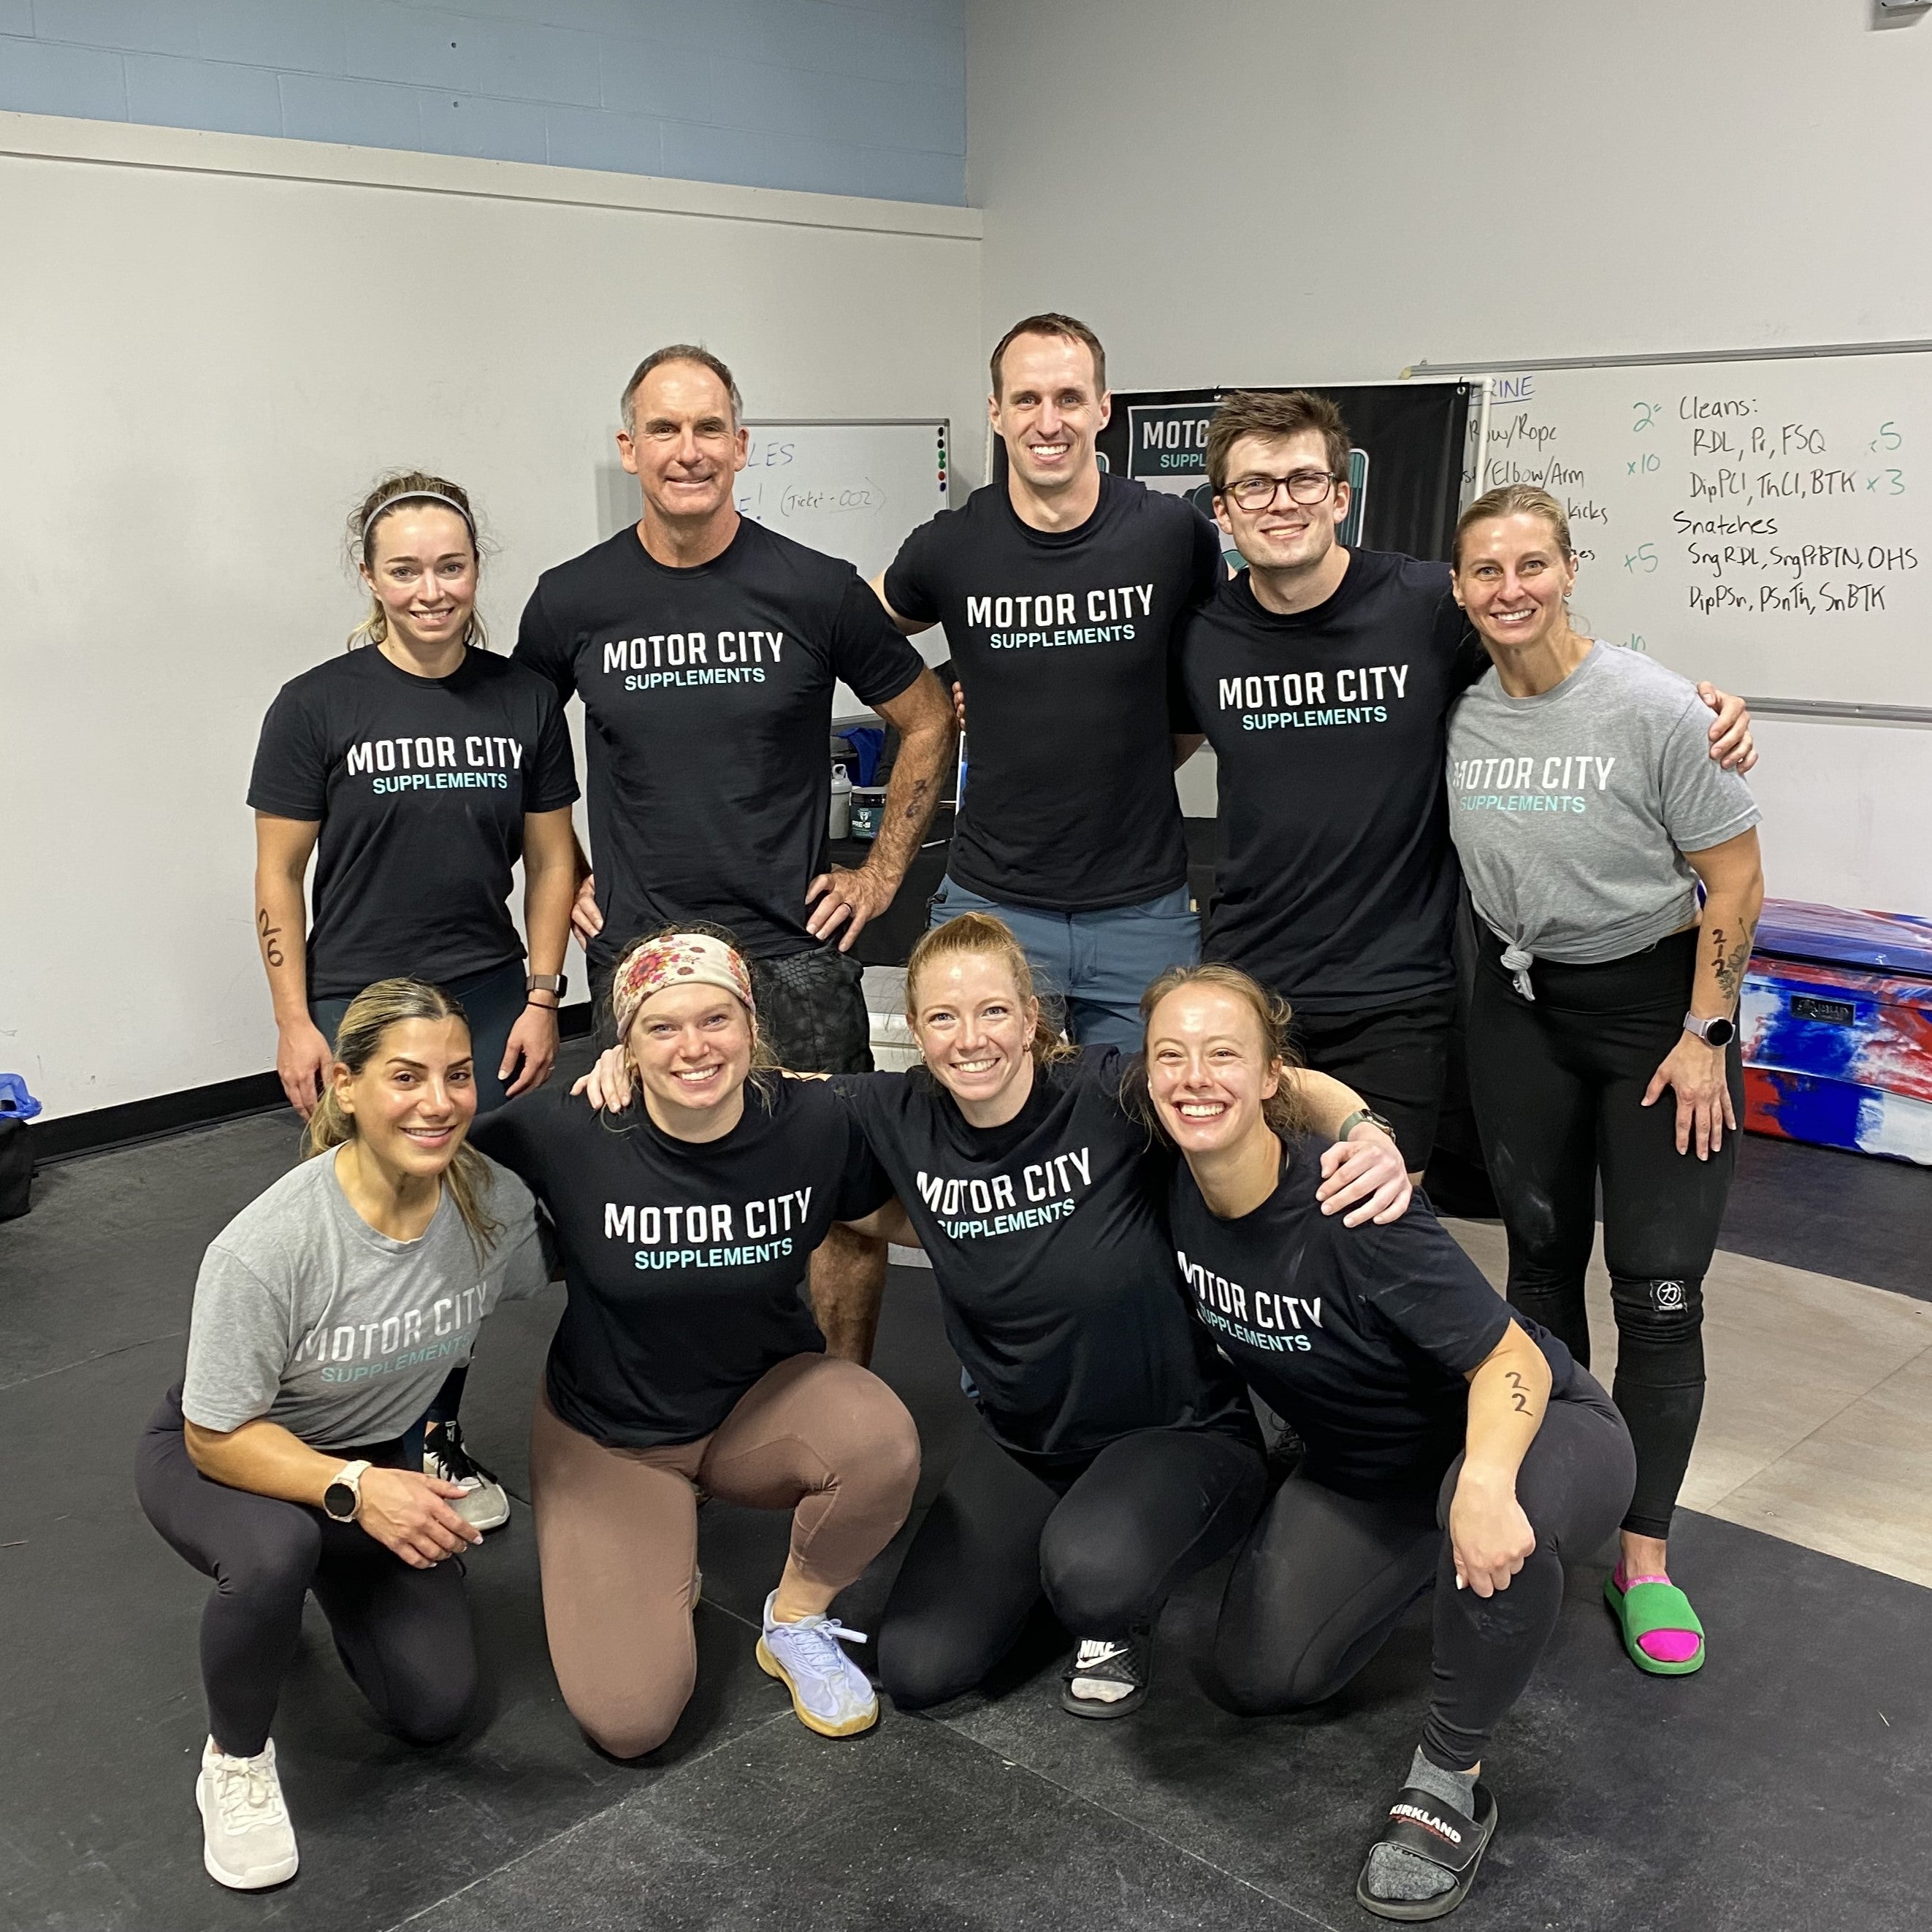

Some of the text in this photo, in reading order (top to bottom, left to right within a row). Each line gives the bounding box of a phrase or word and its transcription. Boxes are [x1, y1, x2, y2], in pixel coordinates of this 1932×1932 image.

[1680, 396, 1758, 419] Cleans:
[1142, 419, 1209, 450] MOTO
[1469, 413, 1558, 451] Rw/Rope
[1782, 424, 1826, 455] FSQ
[1567, 497, 1608, 524] kicks
[1673, 511, 1778, 535] Snatches
[1867, 546, 1918, 570] OHS
[967, 584, 1154, 628] MOTOR CITY
[603, 630, 784, 673] MOTOR CITY
[990, 624, 1135, 649] SUPPLEMENTS
[624, 667, 766, 692] SUPPLEMENTS
[1218, 664, 1410, 711] MOTOR CITY
[1242, 705, 1388, 730] SUPPLEMENTS
[347, 736, 523, 776] MOTOR CITY
[1453, 755, 1616, 791] MOTOR CITY
[373, 772, 508, 795] SUPPLEMENTS
[1460, 795, 1586, 814] SUPPLEMENTS
[259, 908, 284, 967] 26
[917, 1148, 1092, 1215] MOTOR CITY
[604, 1186, 813, 1244] MOTOR CITY
[938, 1199, 1076, 1240] SUPPLEMENTS
[634, 1238, 793, 1269] SUPPLEMENTS
[1177, 1251, 1324, 1330] MOTOR CITY
[295, 1280, 488, 1362] MOTOR CITY
[321, 1331, 471, 1383] SUPPLEMENTS
[1504, 1371, 1533, 1416] 22
[1080, 1640, 1115, 1659] NIKE
[1389, 1804, 1462, 1844] KIRKLAND
